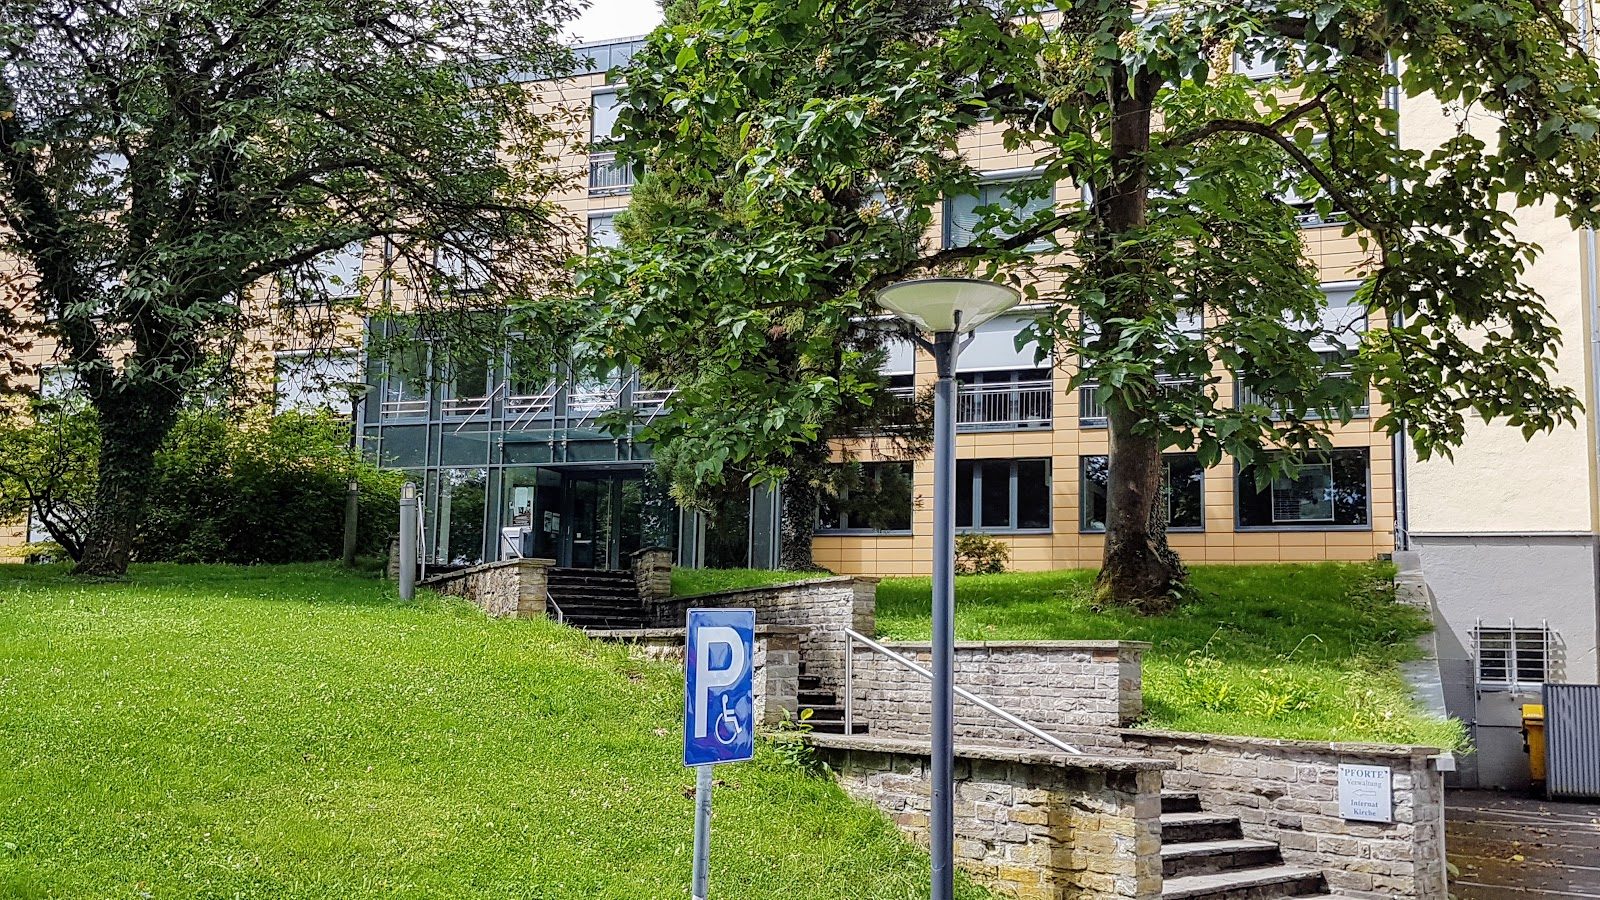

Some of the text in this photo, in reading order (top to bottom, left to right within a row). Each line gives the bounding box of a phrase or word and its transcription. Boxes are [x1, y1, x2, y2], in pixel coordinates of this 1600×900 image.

[694, 626, 745, 739] P
[1344, 769, 1384, 779] PFORTE
[1347, 779, 1382, 788] Verwaltung
[1350, 799, 1379, 808] Internat
[1353, 809, 1377, 817] Kirche
